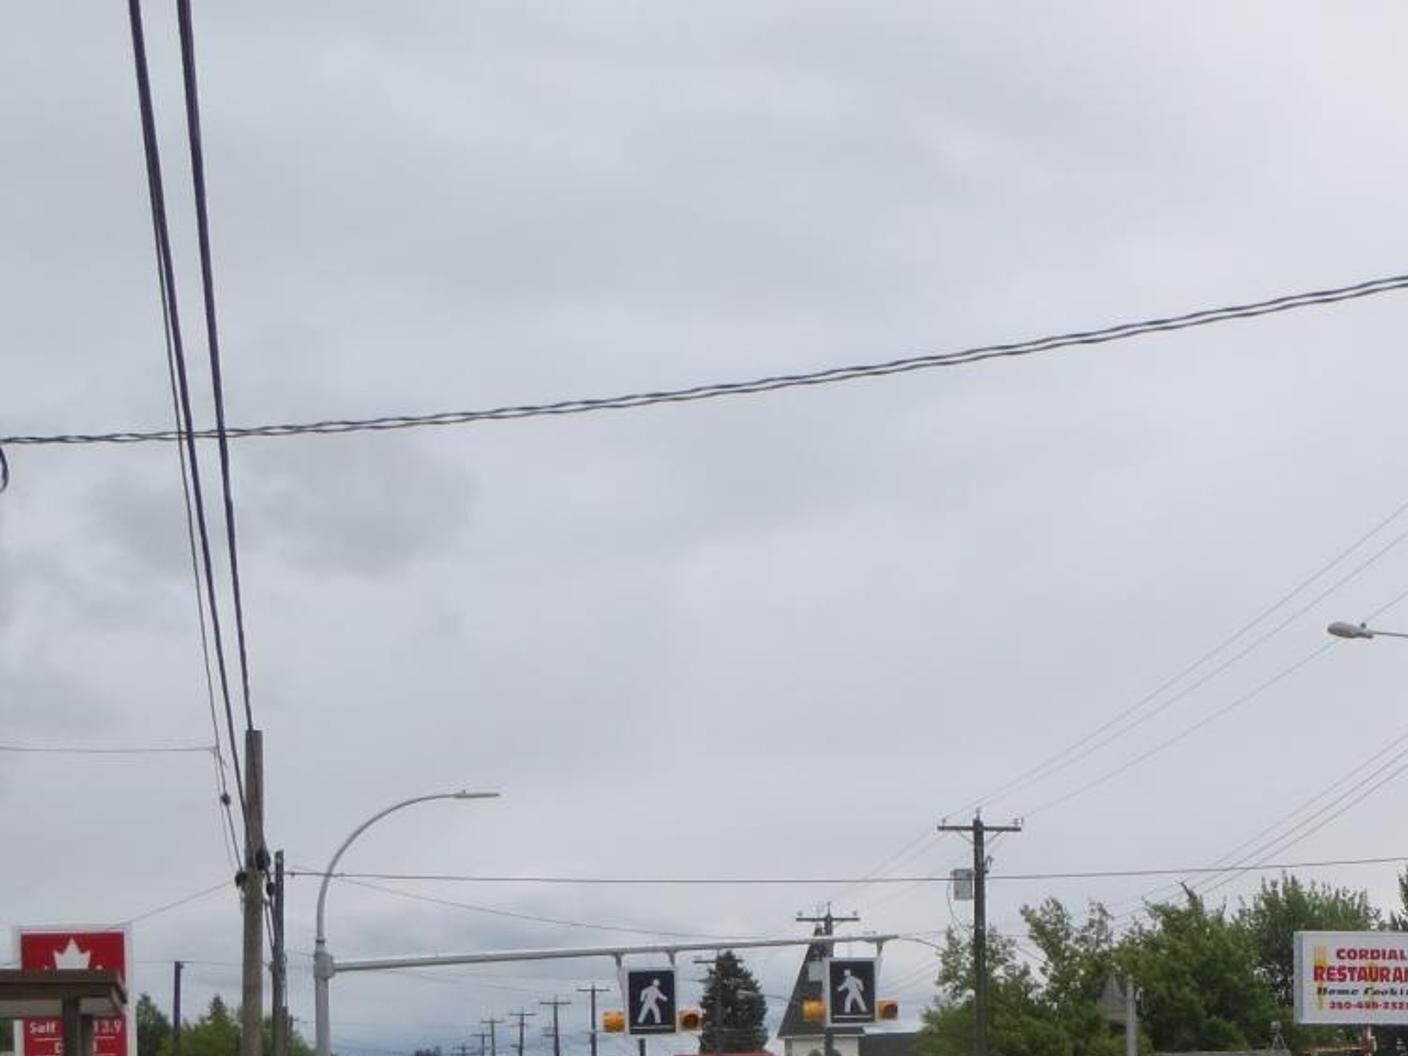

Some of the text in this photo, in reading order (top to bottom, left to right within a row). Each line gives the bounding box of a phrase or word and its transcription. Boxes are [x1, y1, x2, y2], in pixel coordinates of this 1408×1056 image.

[1336, 948, 1408, 961] CORDIAL
[1316, 986, 1359, 997] Home
[29, 1020, 56, 1034] Self
